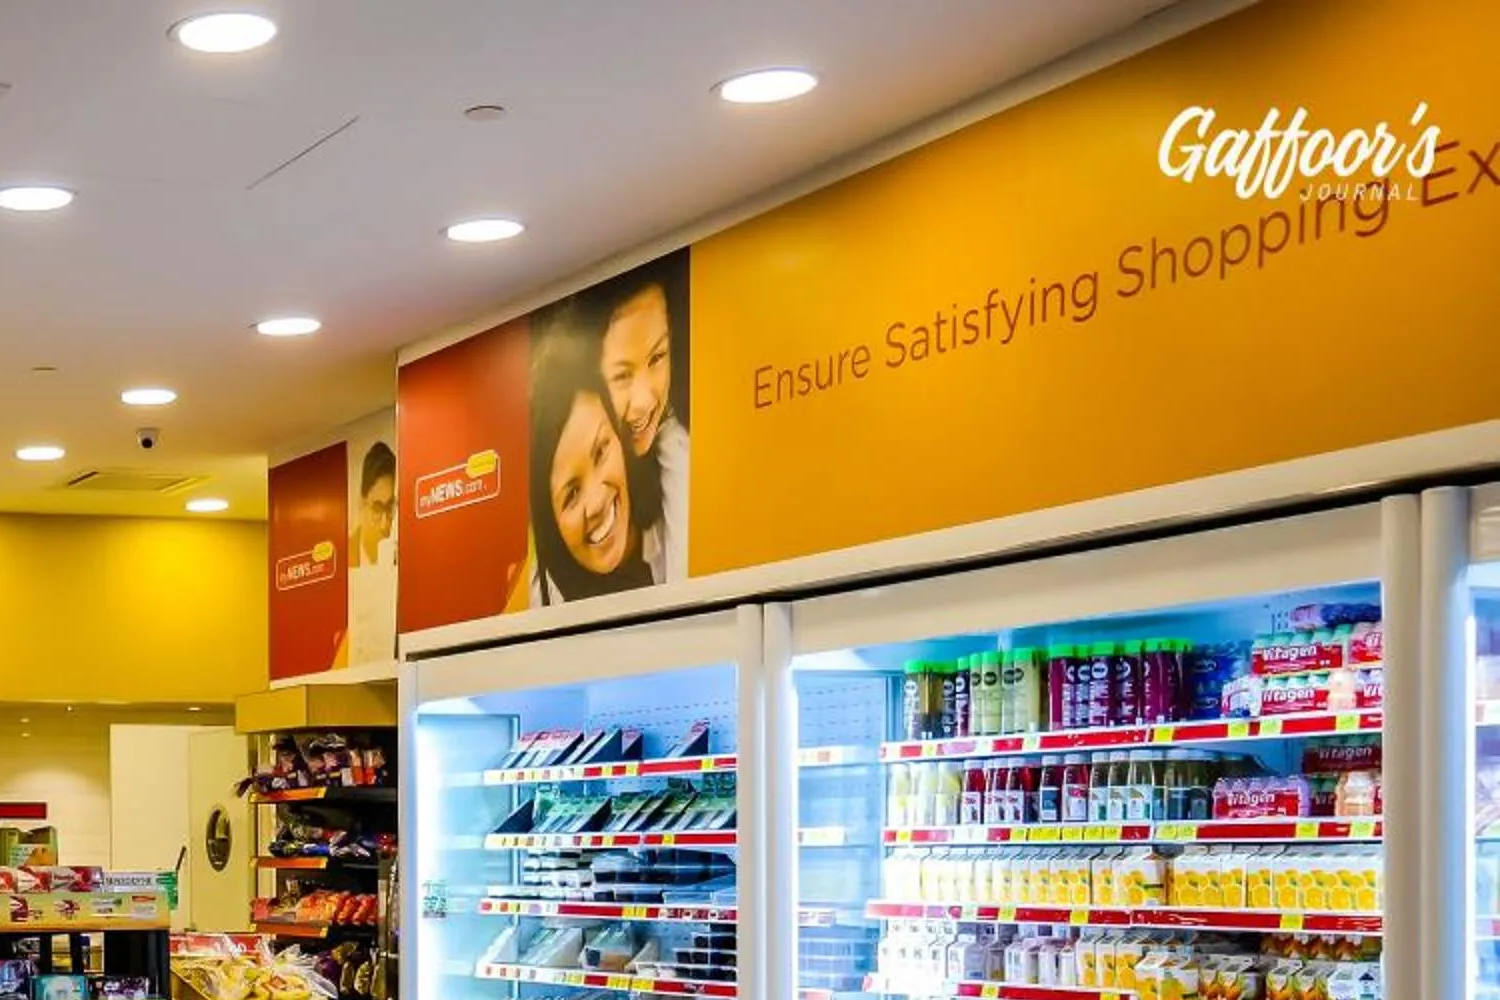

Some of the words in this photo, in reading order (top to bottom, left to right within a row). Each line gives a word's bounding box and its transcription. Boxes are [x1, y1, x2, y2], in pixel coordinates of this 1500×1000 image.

[753, 344, 871, 410] Ensure
[884, 270, 1100, 370] Satisfying
[1115, 177, 1390, 299] Shopping
[1262, 643, 1318, 662] Vitagen
